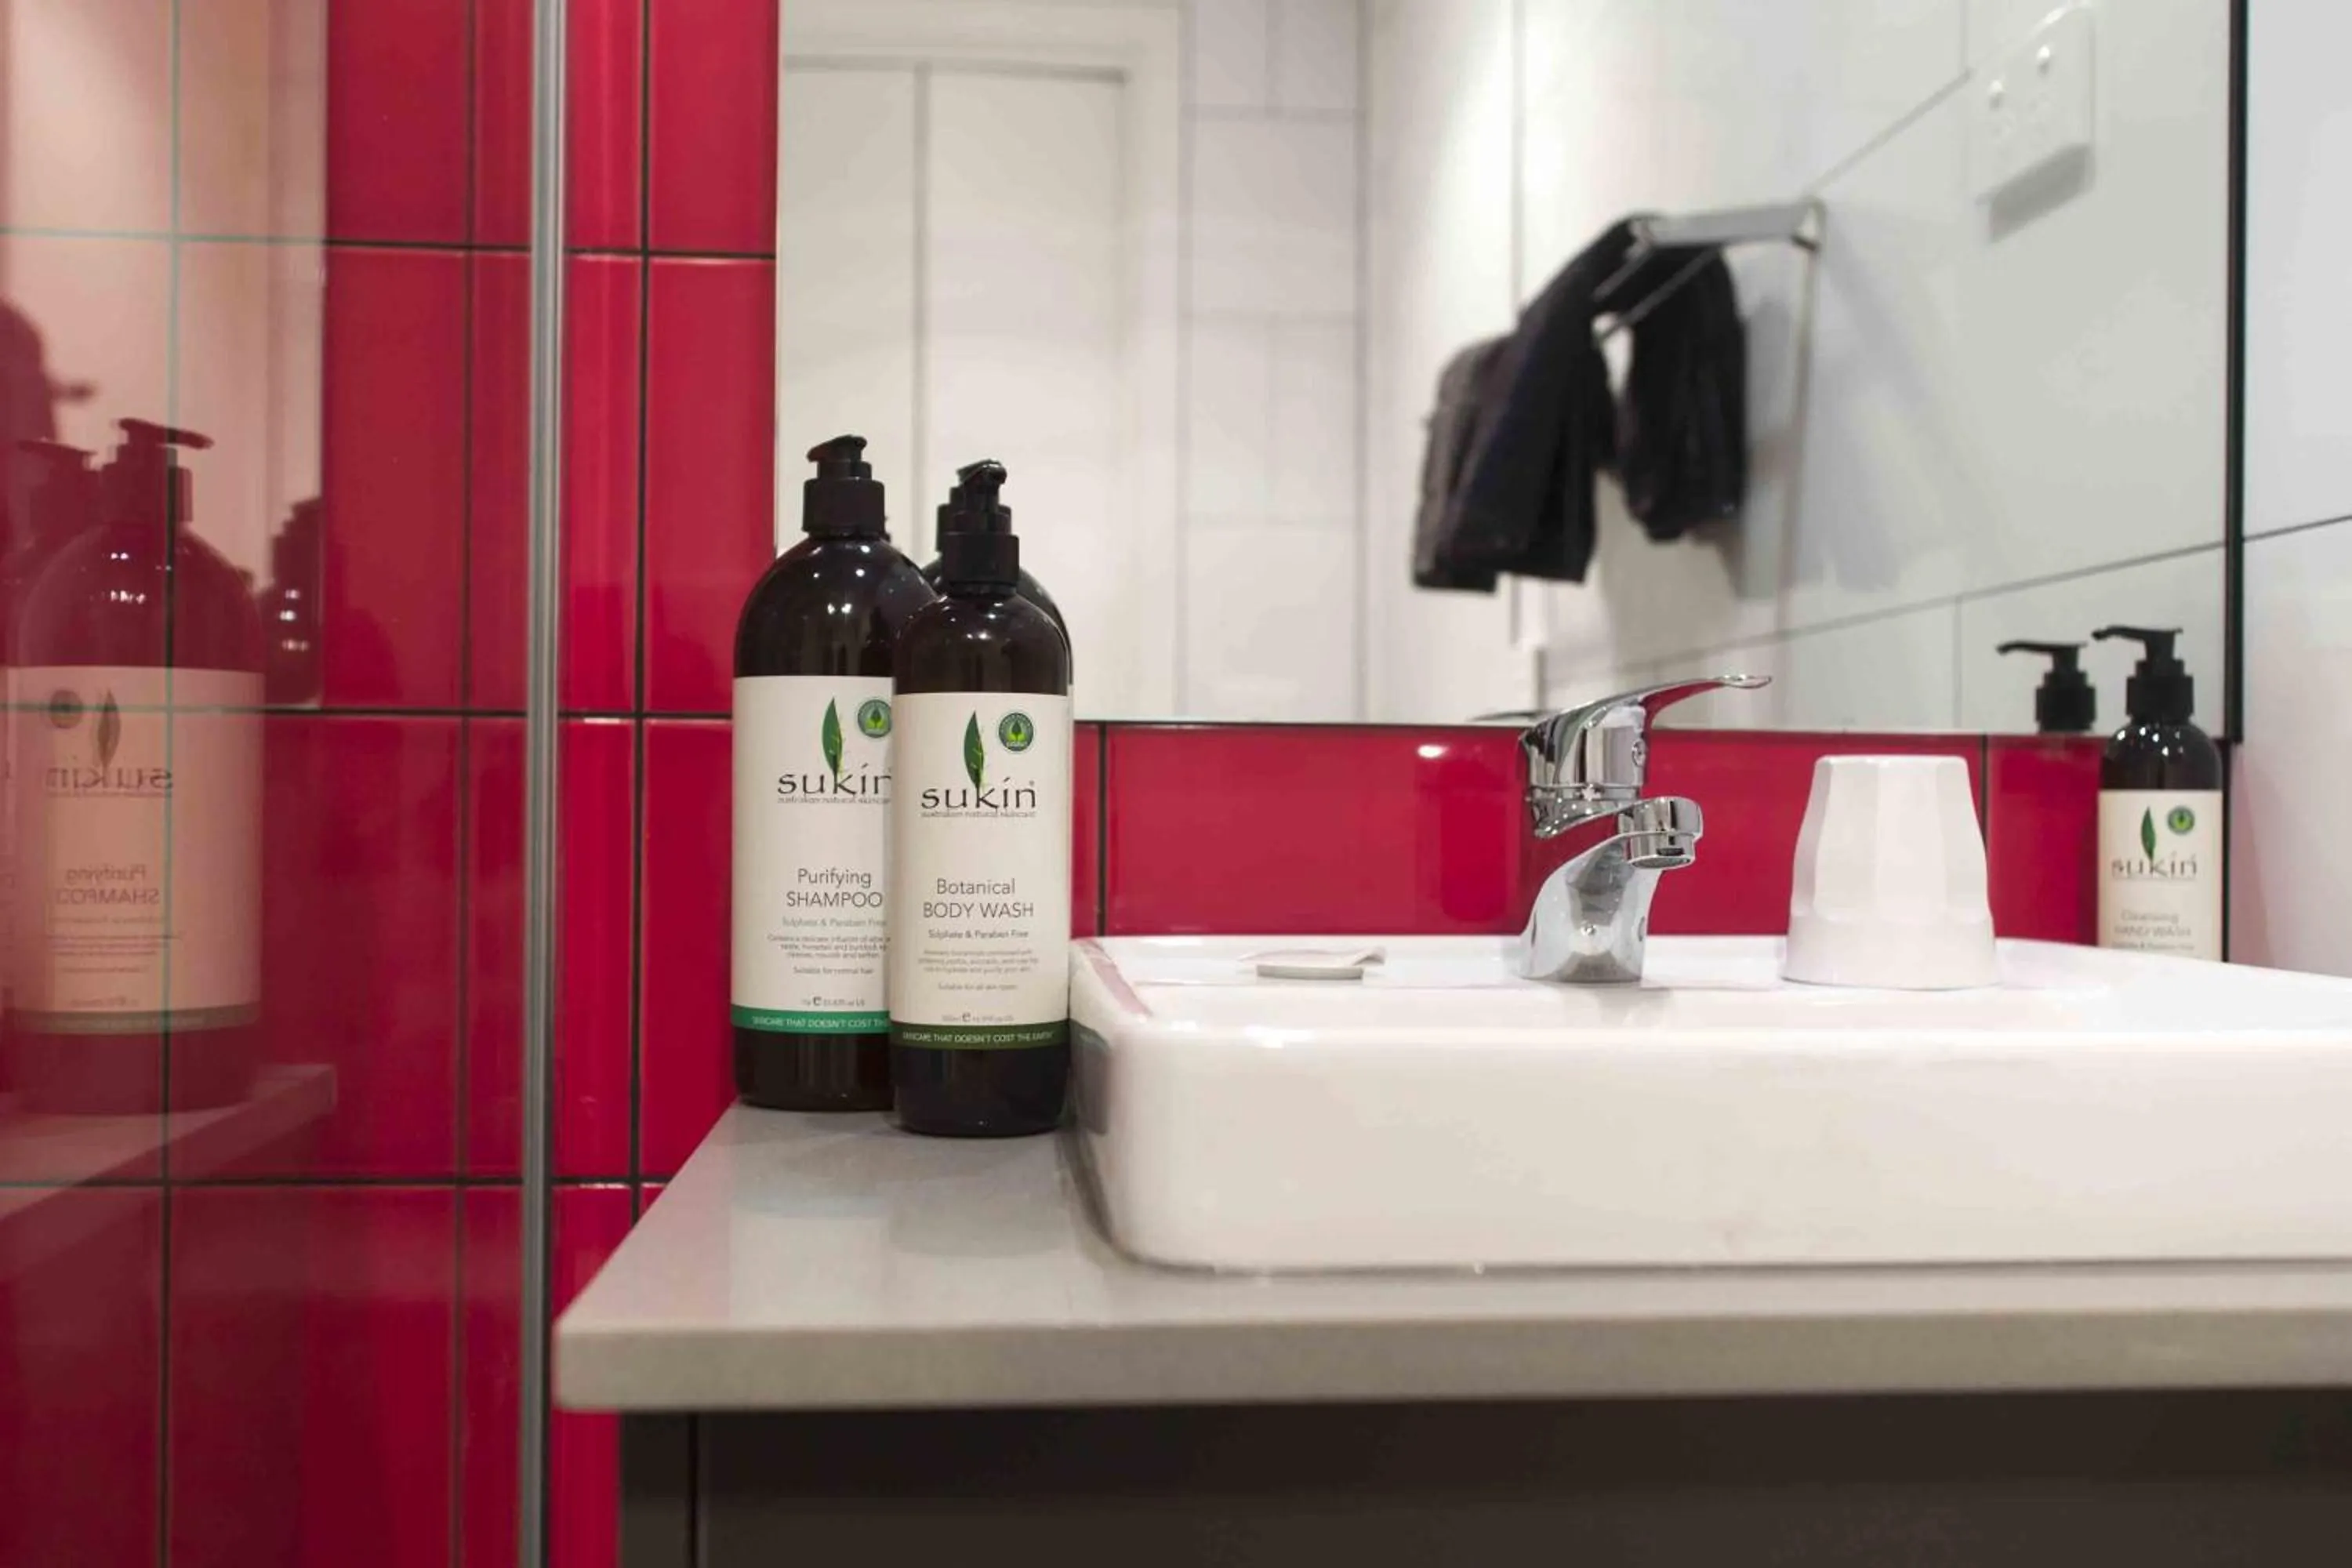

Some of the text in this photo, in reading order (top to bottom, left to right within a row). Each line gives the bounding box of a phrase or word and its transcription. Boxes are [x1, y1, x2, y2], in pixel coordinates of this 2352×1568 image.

[798, 867, 871, 888] Purifying
[937, 877, 1015, 895] Botanical
[786, 891, 883, 908] SHAMPOO
[923, 902, 1034, 919] BODY WASH
[1011, 929, 1029, 938] Free
[848, 1019, 871, 1028] COST
